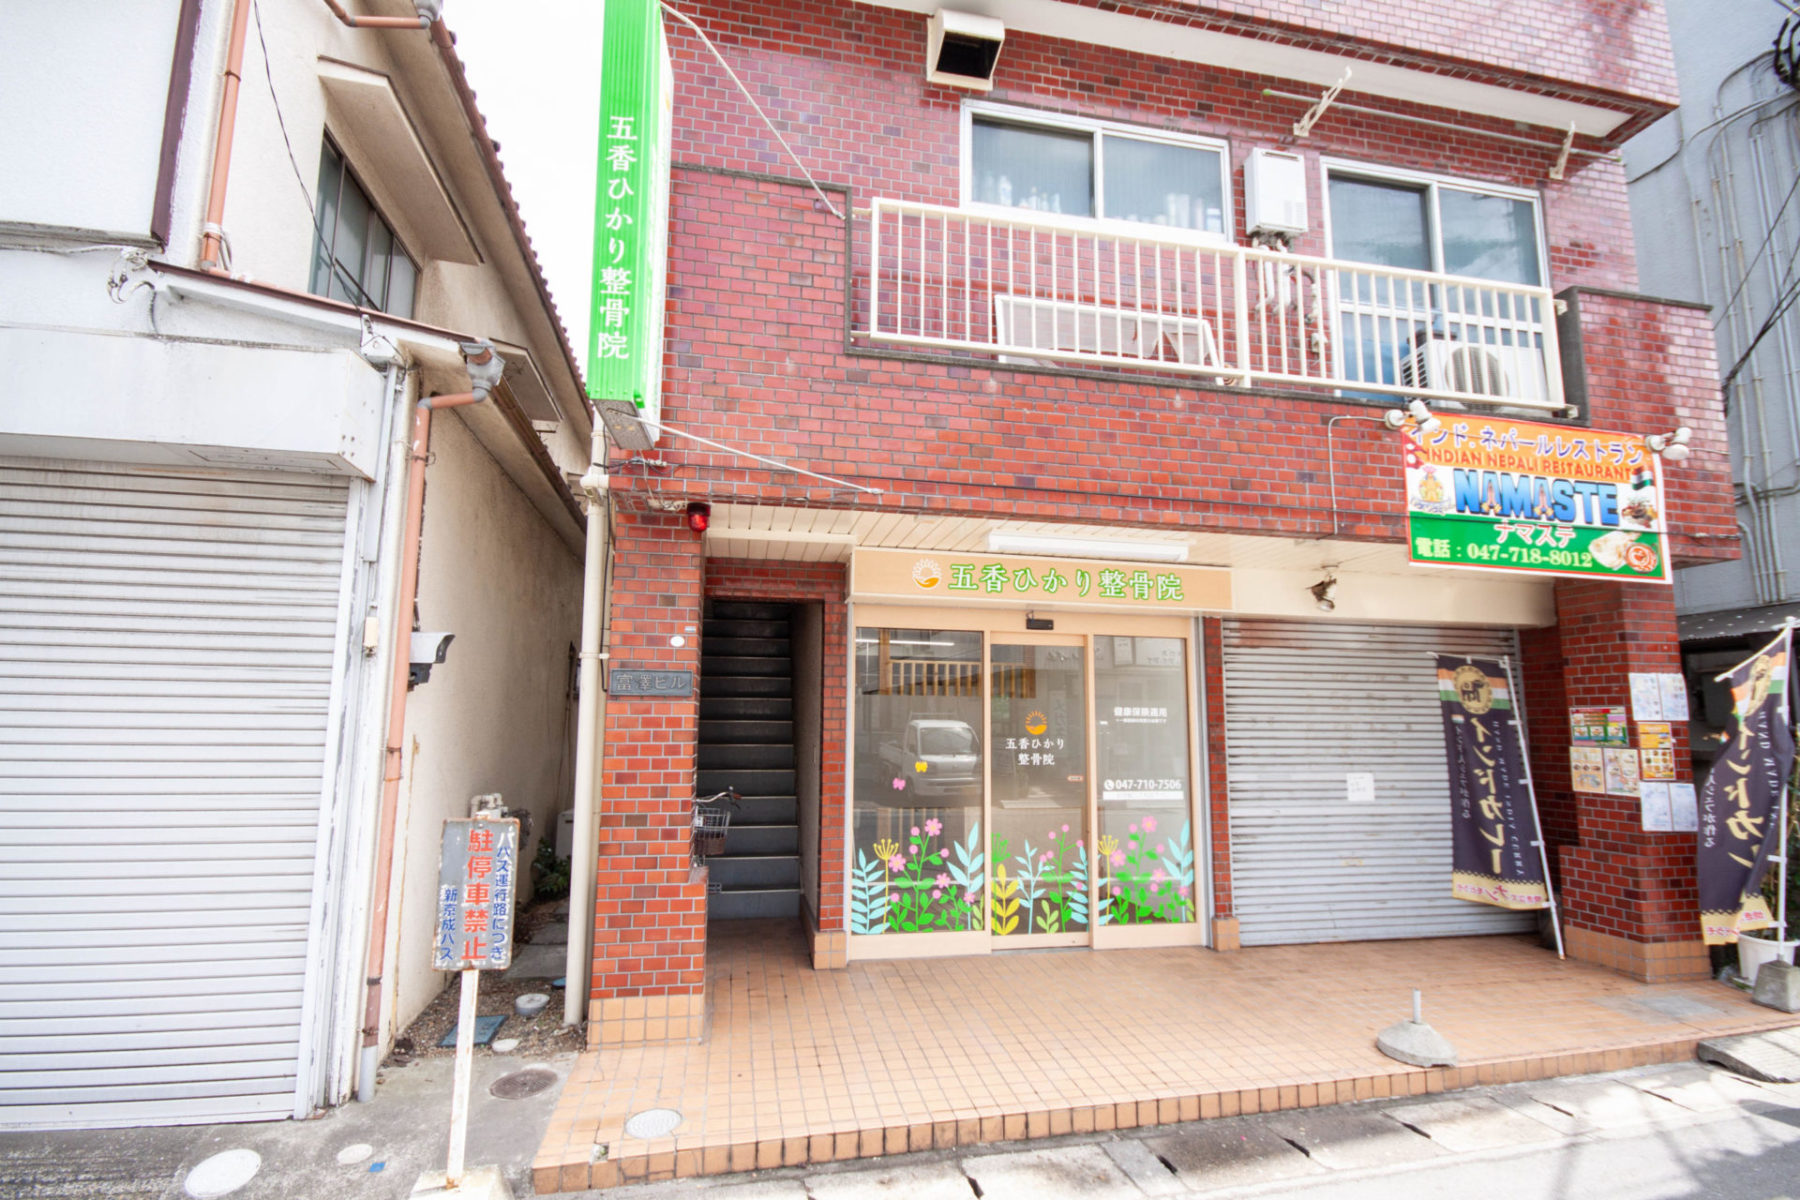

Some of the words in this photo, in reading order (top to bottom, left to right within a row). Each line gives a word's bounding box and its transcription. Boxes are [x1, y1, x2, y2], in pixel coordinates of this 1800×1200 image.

[597, 115, 638, 359] 五香ひかり整骨院
[1426, 448, 1483, 467] INDIAN
[1487, 452, 1538, 473] NEPALI
[1542, 457, 1631, 481] RESTAURANT
[1453, 468, 1620, 527] NAMASTE
[1494, 522, 1576, 548] ナマステ
[949, 563, 1184, 601] 五香ひかり整骨院
[1005, 737, 1064, 751] 五香ひかり
[1017, 752, 1056, 766] 整骨院
[1115, 779, 1182, 790] 047-710-7506
[461, 829, 494, 960] 駐停車禁止
[440, 888, 458, 960] 新京成バス
